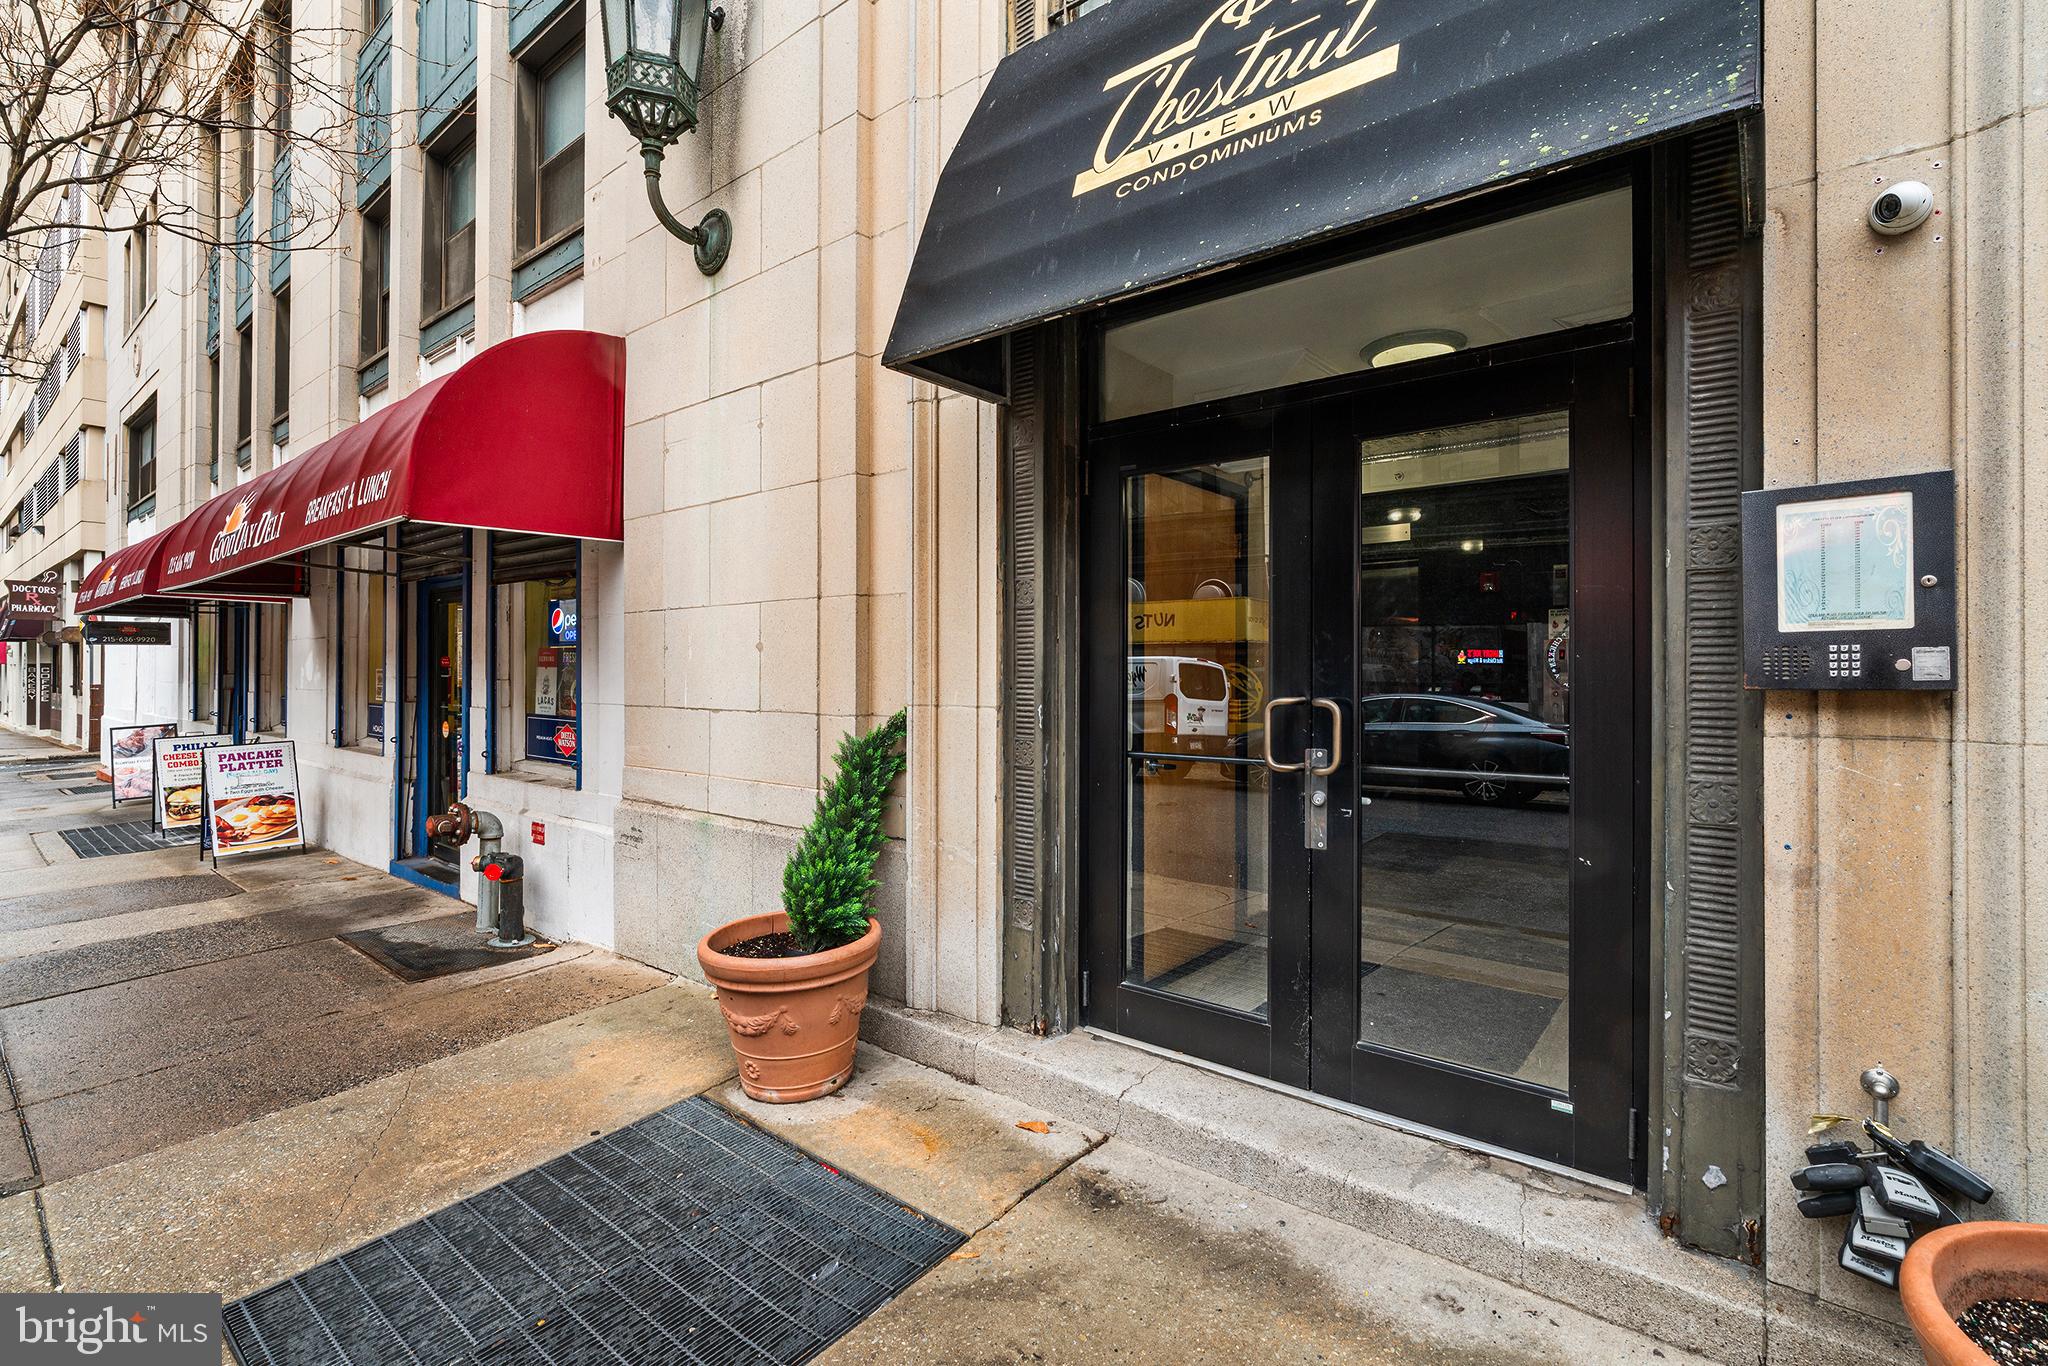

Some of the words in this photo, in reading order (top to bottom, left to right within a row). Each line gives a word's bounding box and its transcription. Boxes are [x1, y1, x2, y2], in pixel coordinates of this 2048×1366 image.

[1093, 0, 1377, 172] Chestnut
[1115, 108, 1322, 198] CONDOMINIUMS
[305, 485, 349, 525] BREAKFAST
[347, 481, 355, 509] &
[357, 469, 392, 506] LUNCH
[12, 584, 57, 594] DOCTORS
[11, 604, 57, 613] PHARMACY
[102, 635, 156, 643] 215-636-9920
[565, 630, 577, 640] OPE
[27, 667, 37, 700] BAKERY
[40, 667, 50, 702] COFFEE
[537, 696, 554, 706] LACAS
[173, 742, 219, 752] PHILLY
[558, 738, 576, 748] WATSON
[163, 752, 198, 761] CHEESE
[218, 749, 283, 762] PANCAKE
[167, 759, 200, 769] COMBO
[219, 759, 283, 772] PLATTER
[1861, 1234, 1896, 1249] Master
